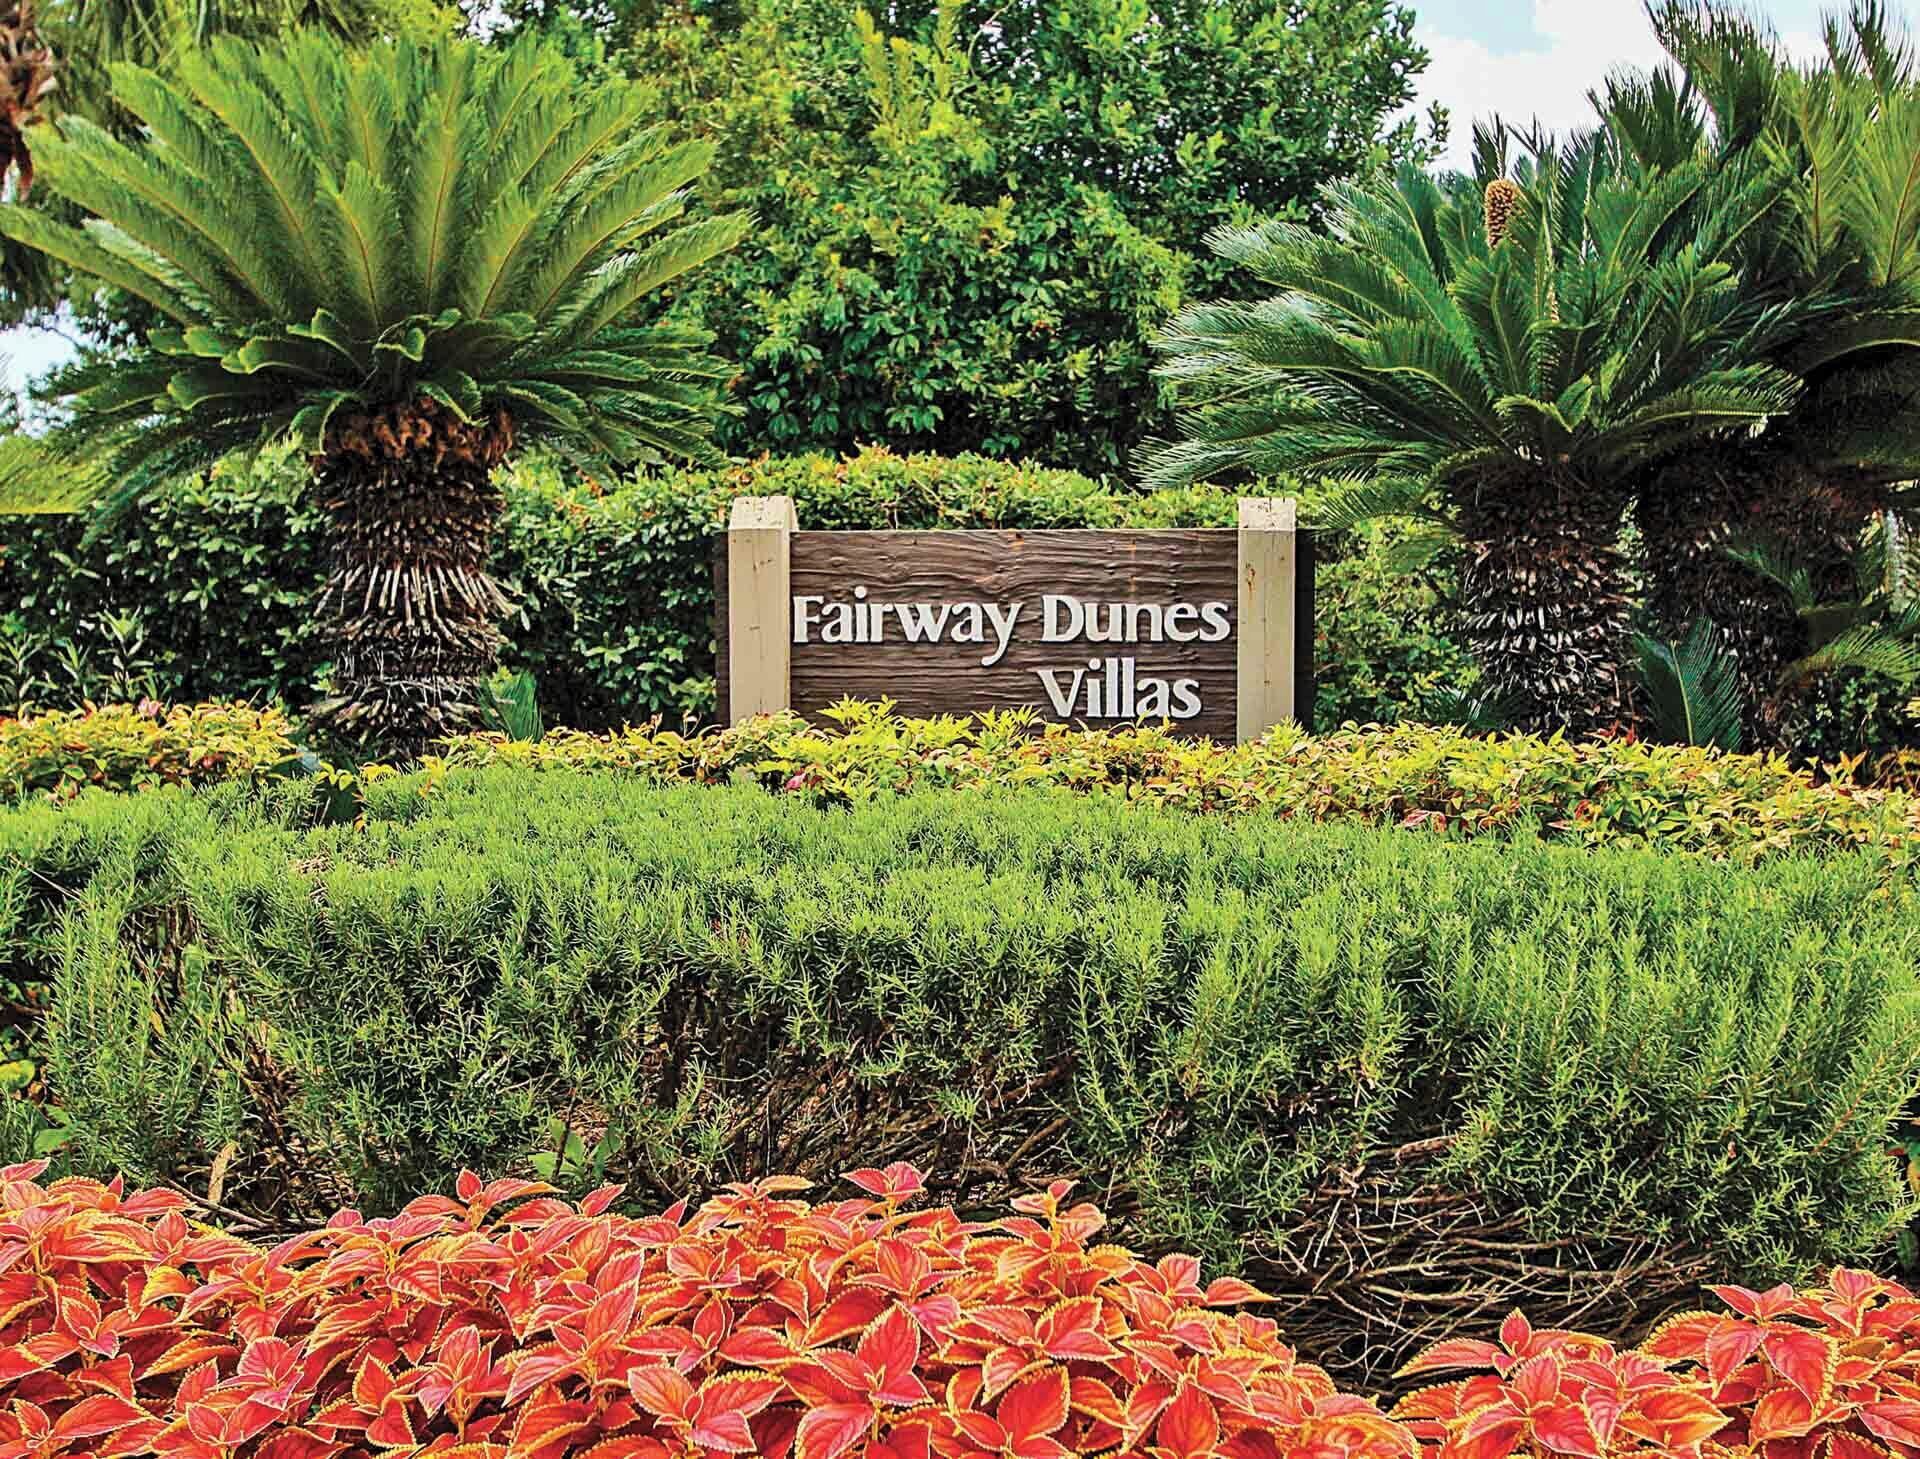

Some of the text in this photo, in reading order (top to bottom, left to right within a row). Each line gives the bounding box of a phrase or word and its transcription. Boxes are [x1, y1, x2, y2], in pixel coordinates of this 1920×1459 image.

[792, 586, 1231, 666] Fairway Dunes
[1036, 657, 1202, 718] Villas
